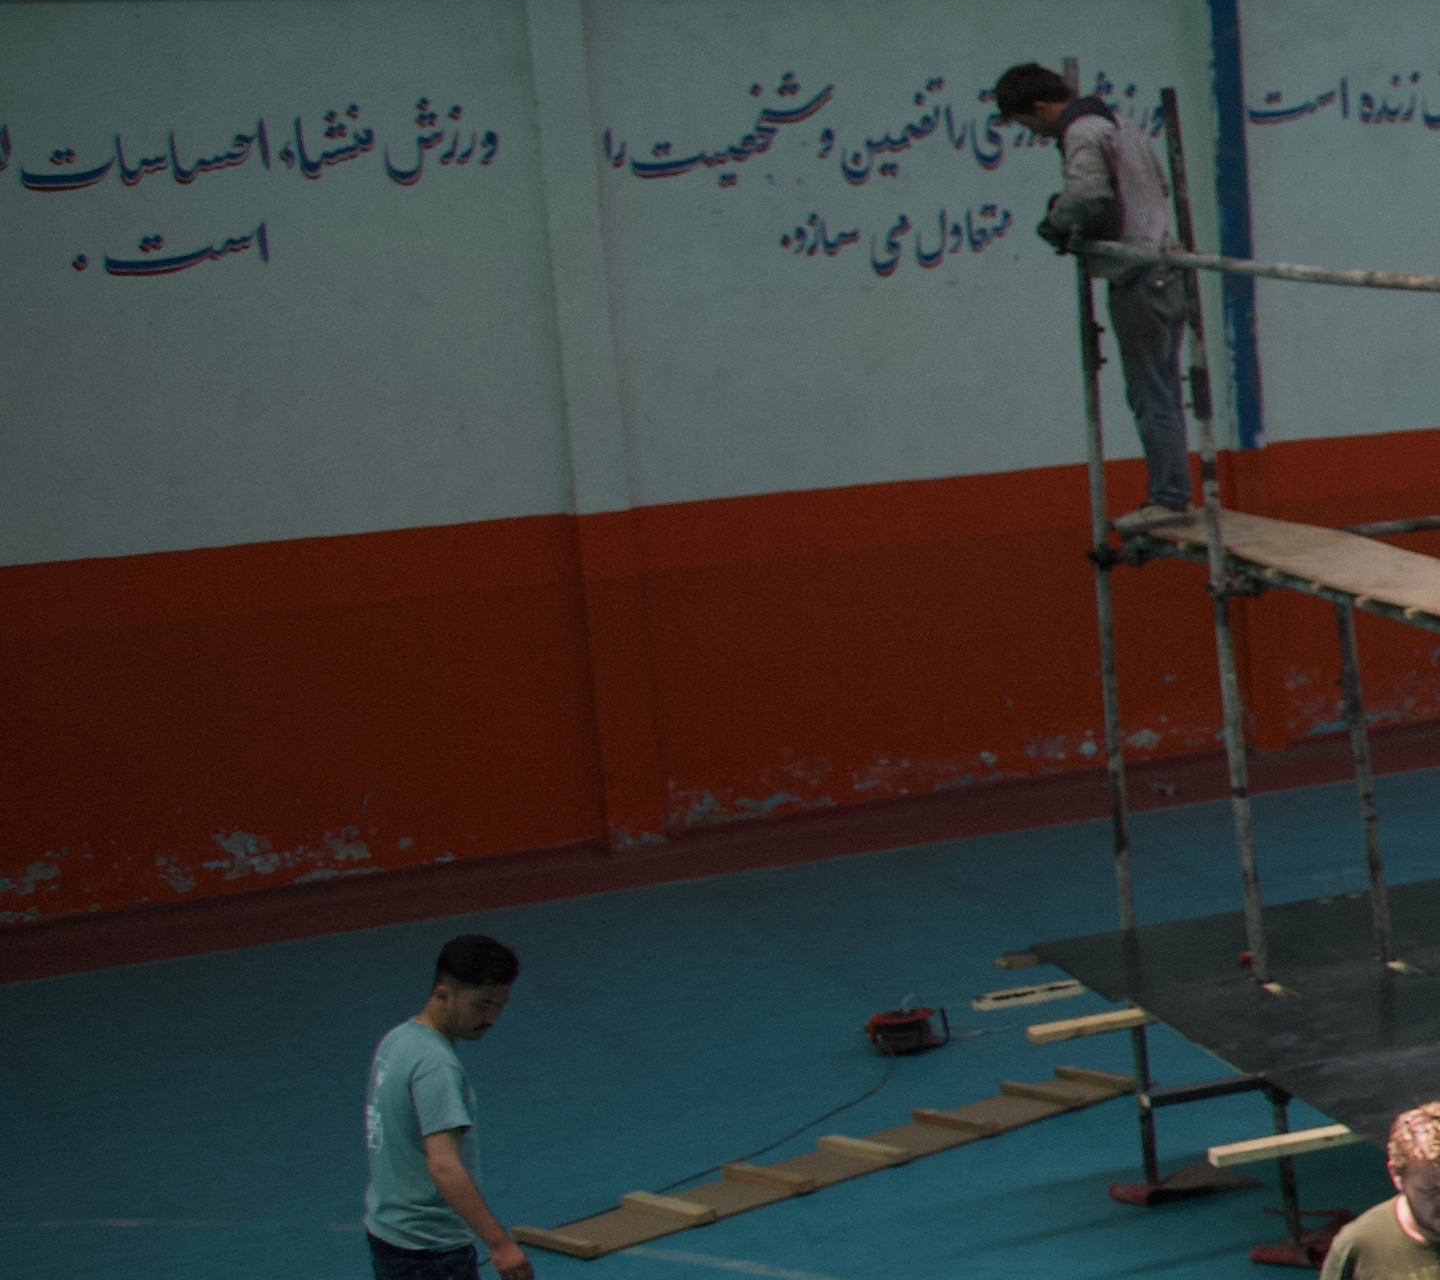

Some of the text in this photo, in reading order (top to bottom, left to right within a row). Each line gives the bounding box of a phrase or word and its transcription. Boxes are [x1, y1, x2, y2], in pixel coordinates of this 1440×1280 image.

[629, 71, 834, 187] شخصیت
[944, 104, 970, 150] را
[1248, 77, 1349, 125] است
[1359, 72, 1421, 123] زنده
[18, 119, 269, 192] احساسات
[384, 97, 498, 186] ورزش
[601, 127, 626, 169] را
[818, 127, 834, 158] و
[840, 77, 945, 185] تضمین
[870, 213, 910, 277] می
[915, 204, 1013, 269] متعادل
